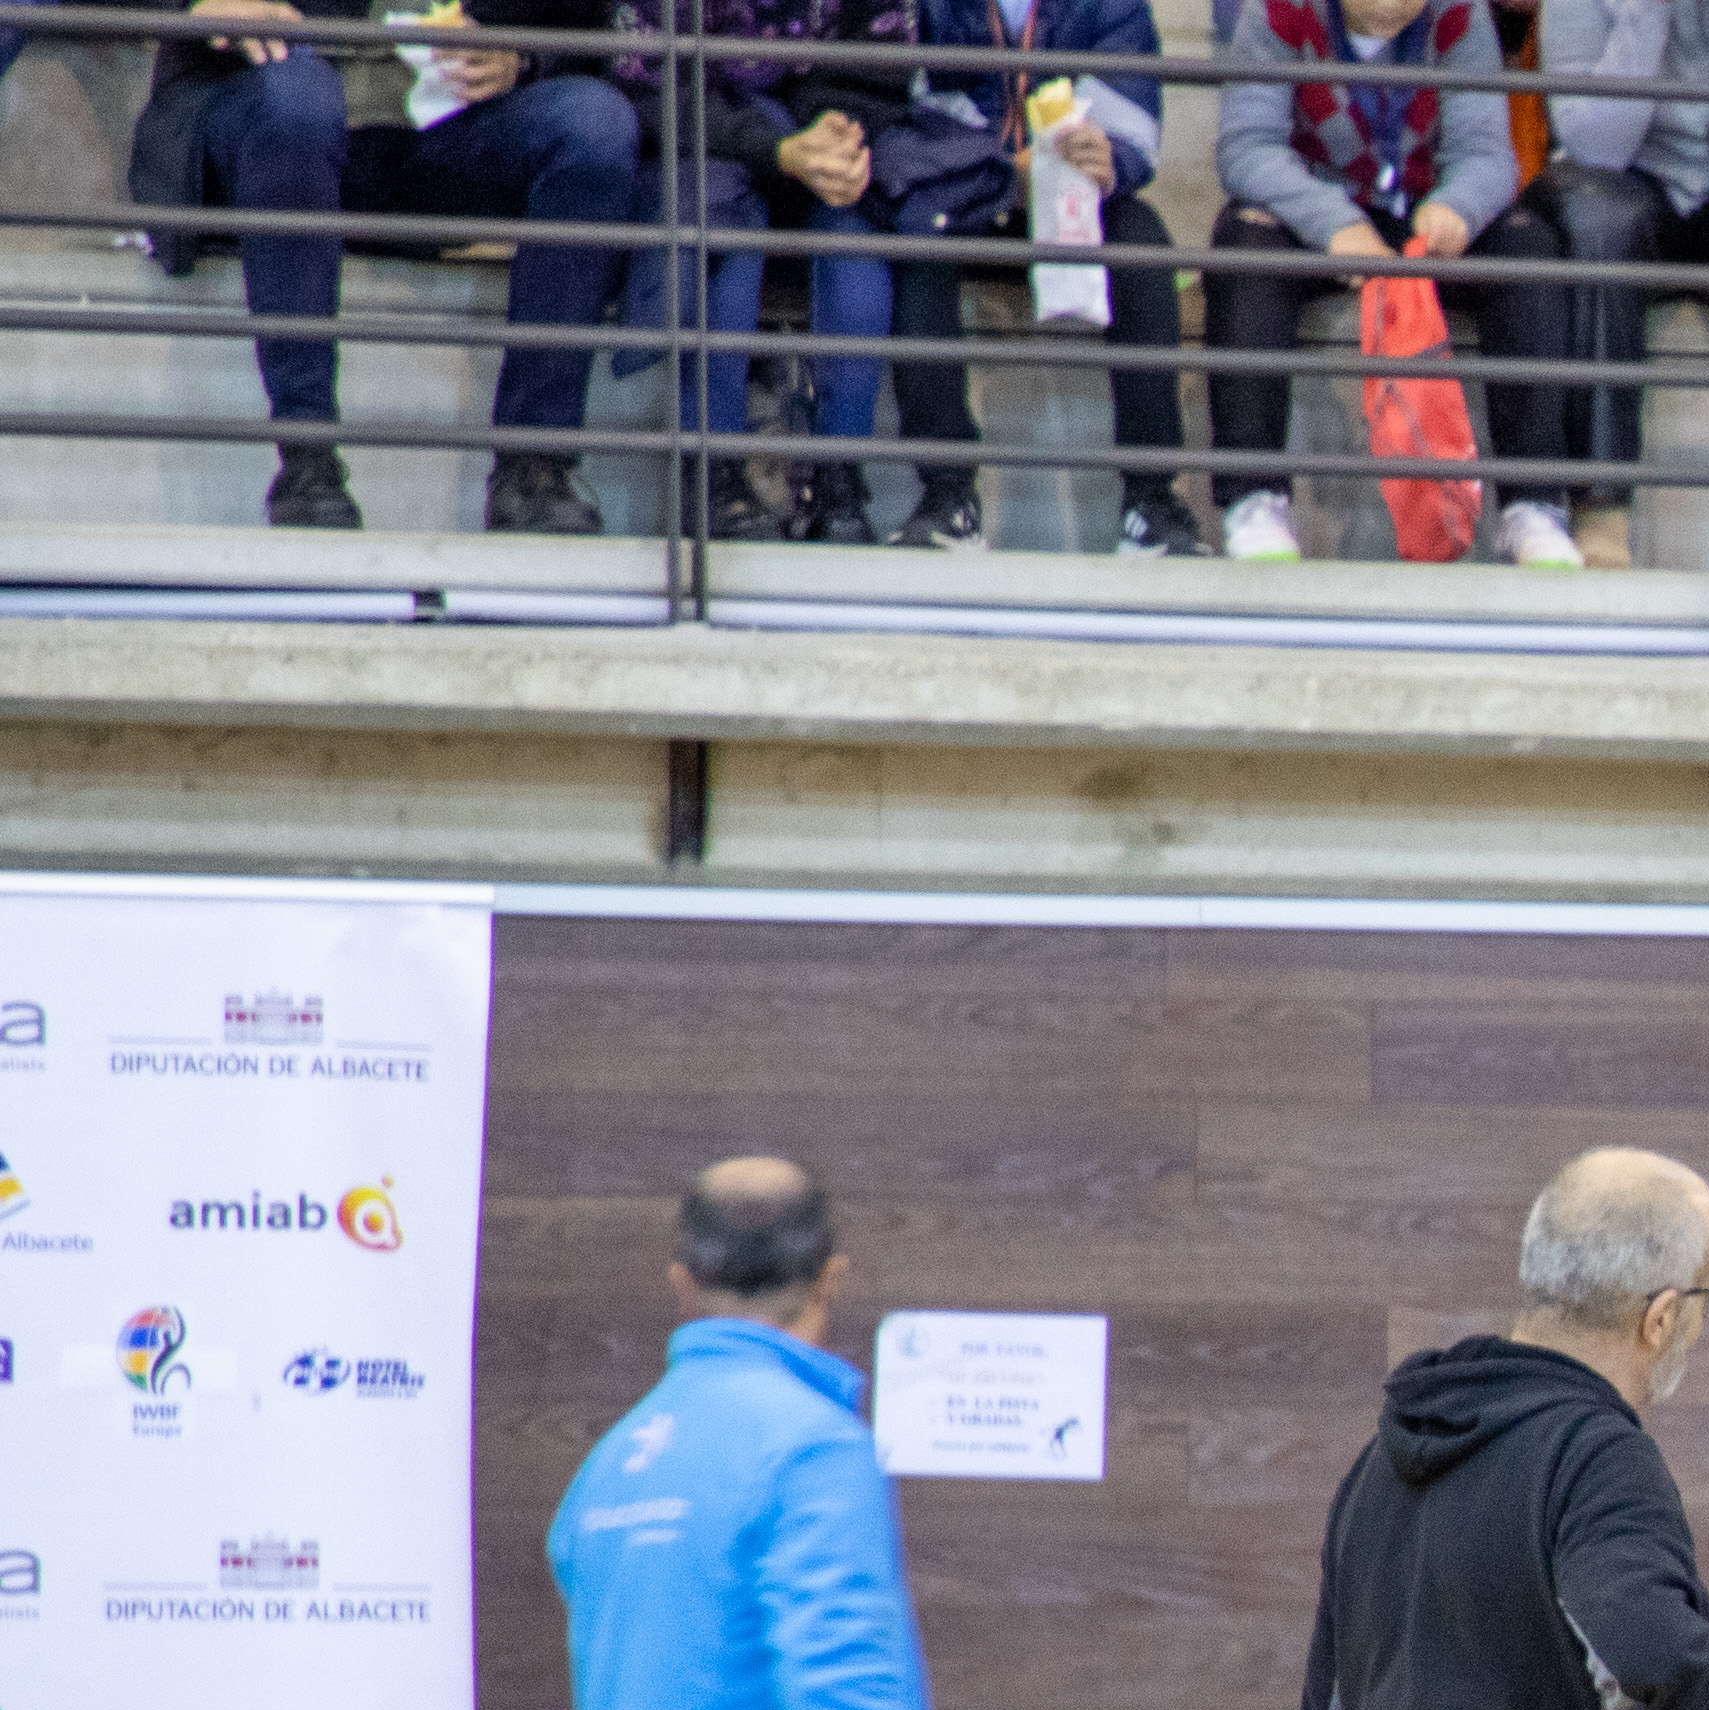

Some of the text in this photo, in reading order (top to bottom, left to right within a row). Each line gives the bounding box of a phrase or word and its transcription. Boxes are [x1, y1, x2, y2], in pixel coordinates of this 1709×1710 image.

[110, 1050, 429, 1082] DIPUTACIÓN DE ALBACETE
[170, 1191, 328, 1231] amiab
[106, 1597, 431, 1623] DIPUTACIÓN DE ALBACETE
